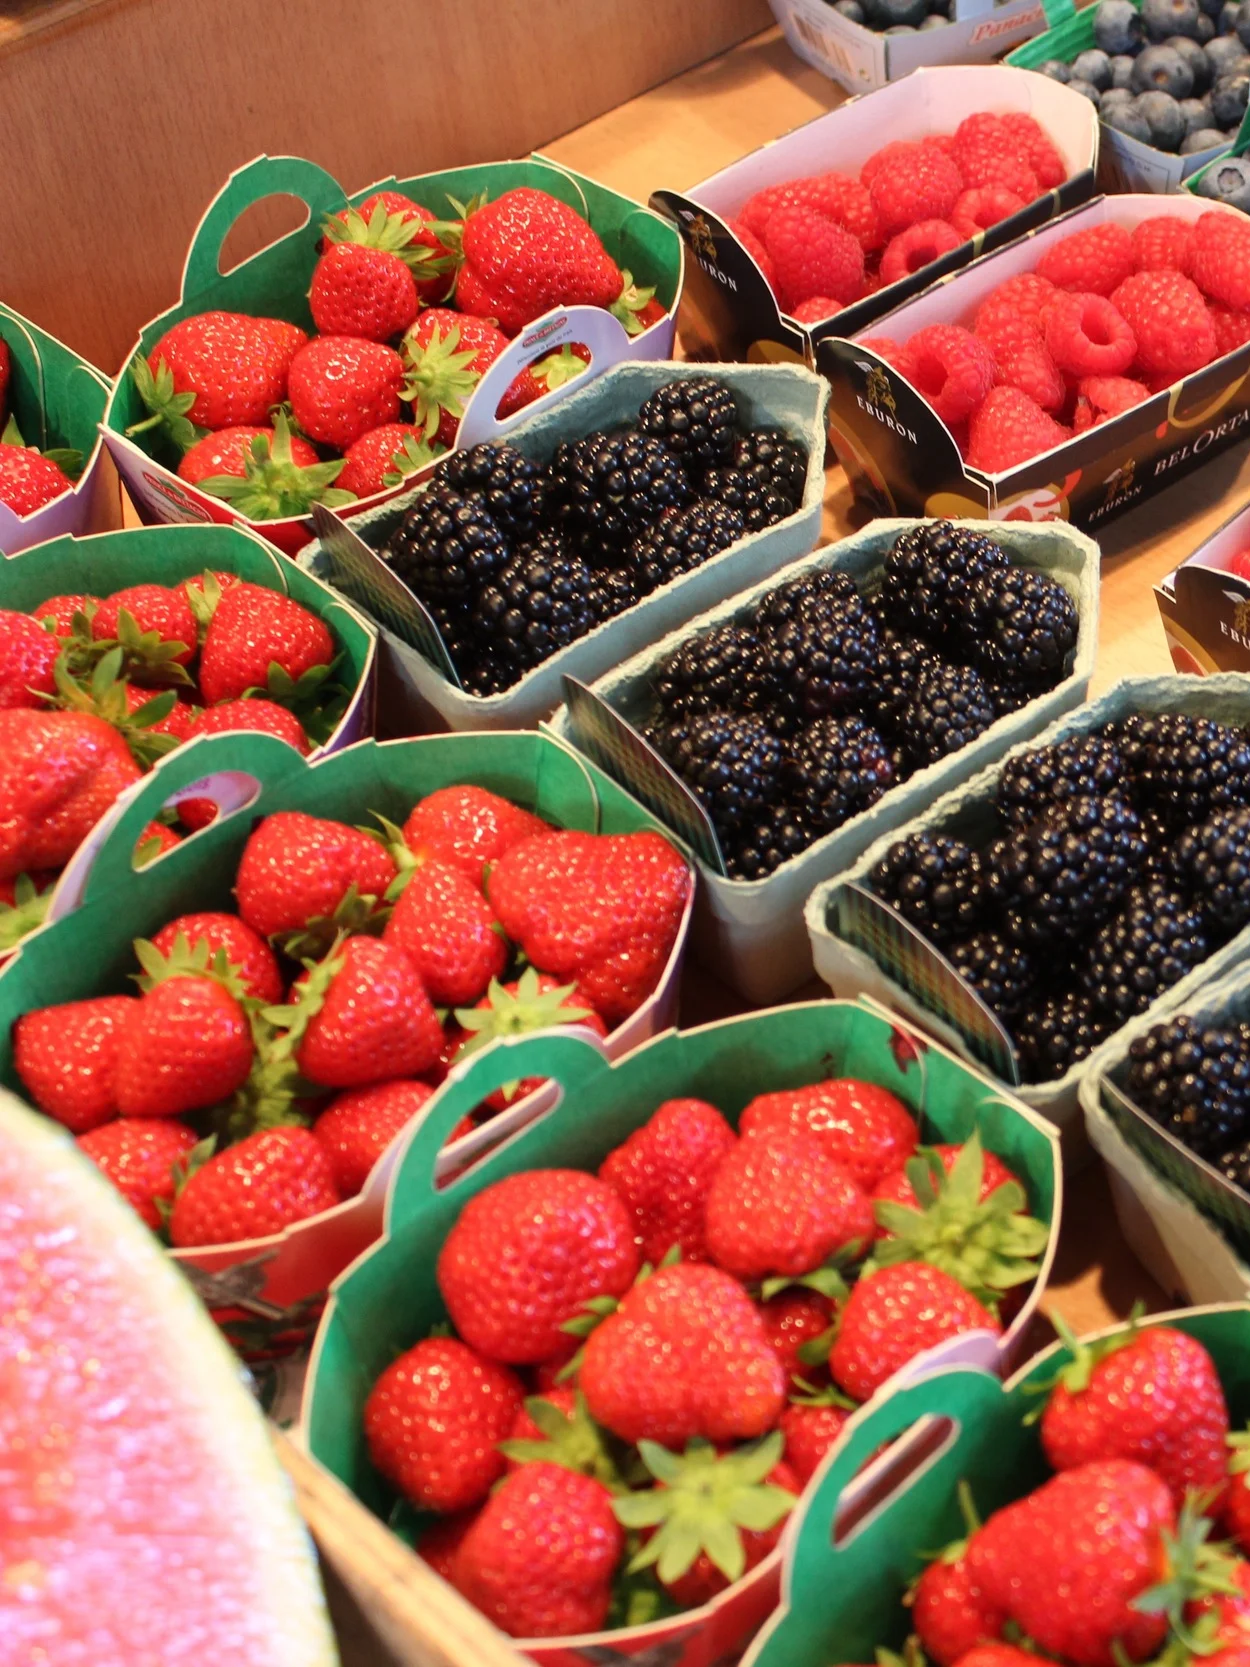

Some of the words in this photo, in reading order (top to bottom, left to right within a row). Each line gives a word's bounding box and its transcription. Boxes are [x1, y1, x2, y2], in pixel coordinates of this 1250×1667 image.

[856, 394, 918, 445] EBURON
[1153, 408, 1250, 476] BELORTA
[1088, 485, 1142, 523] EBURON
